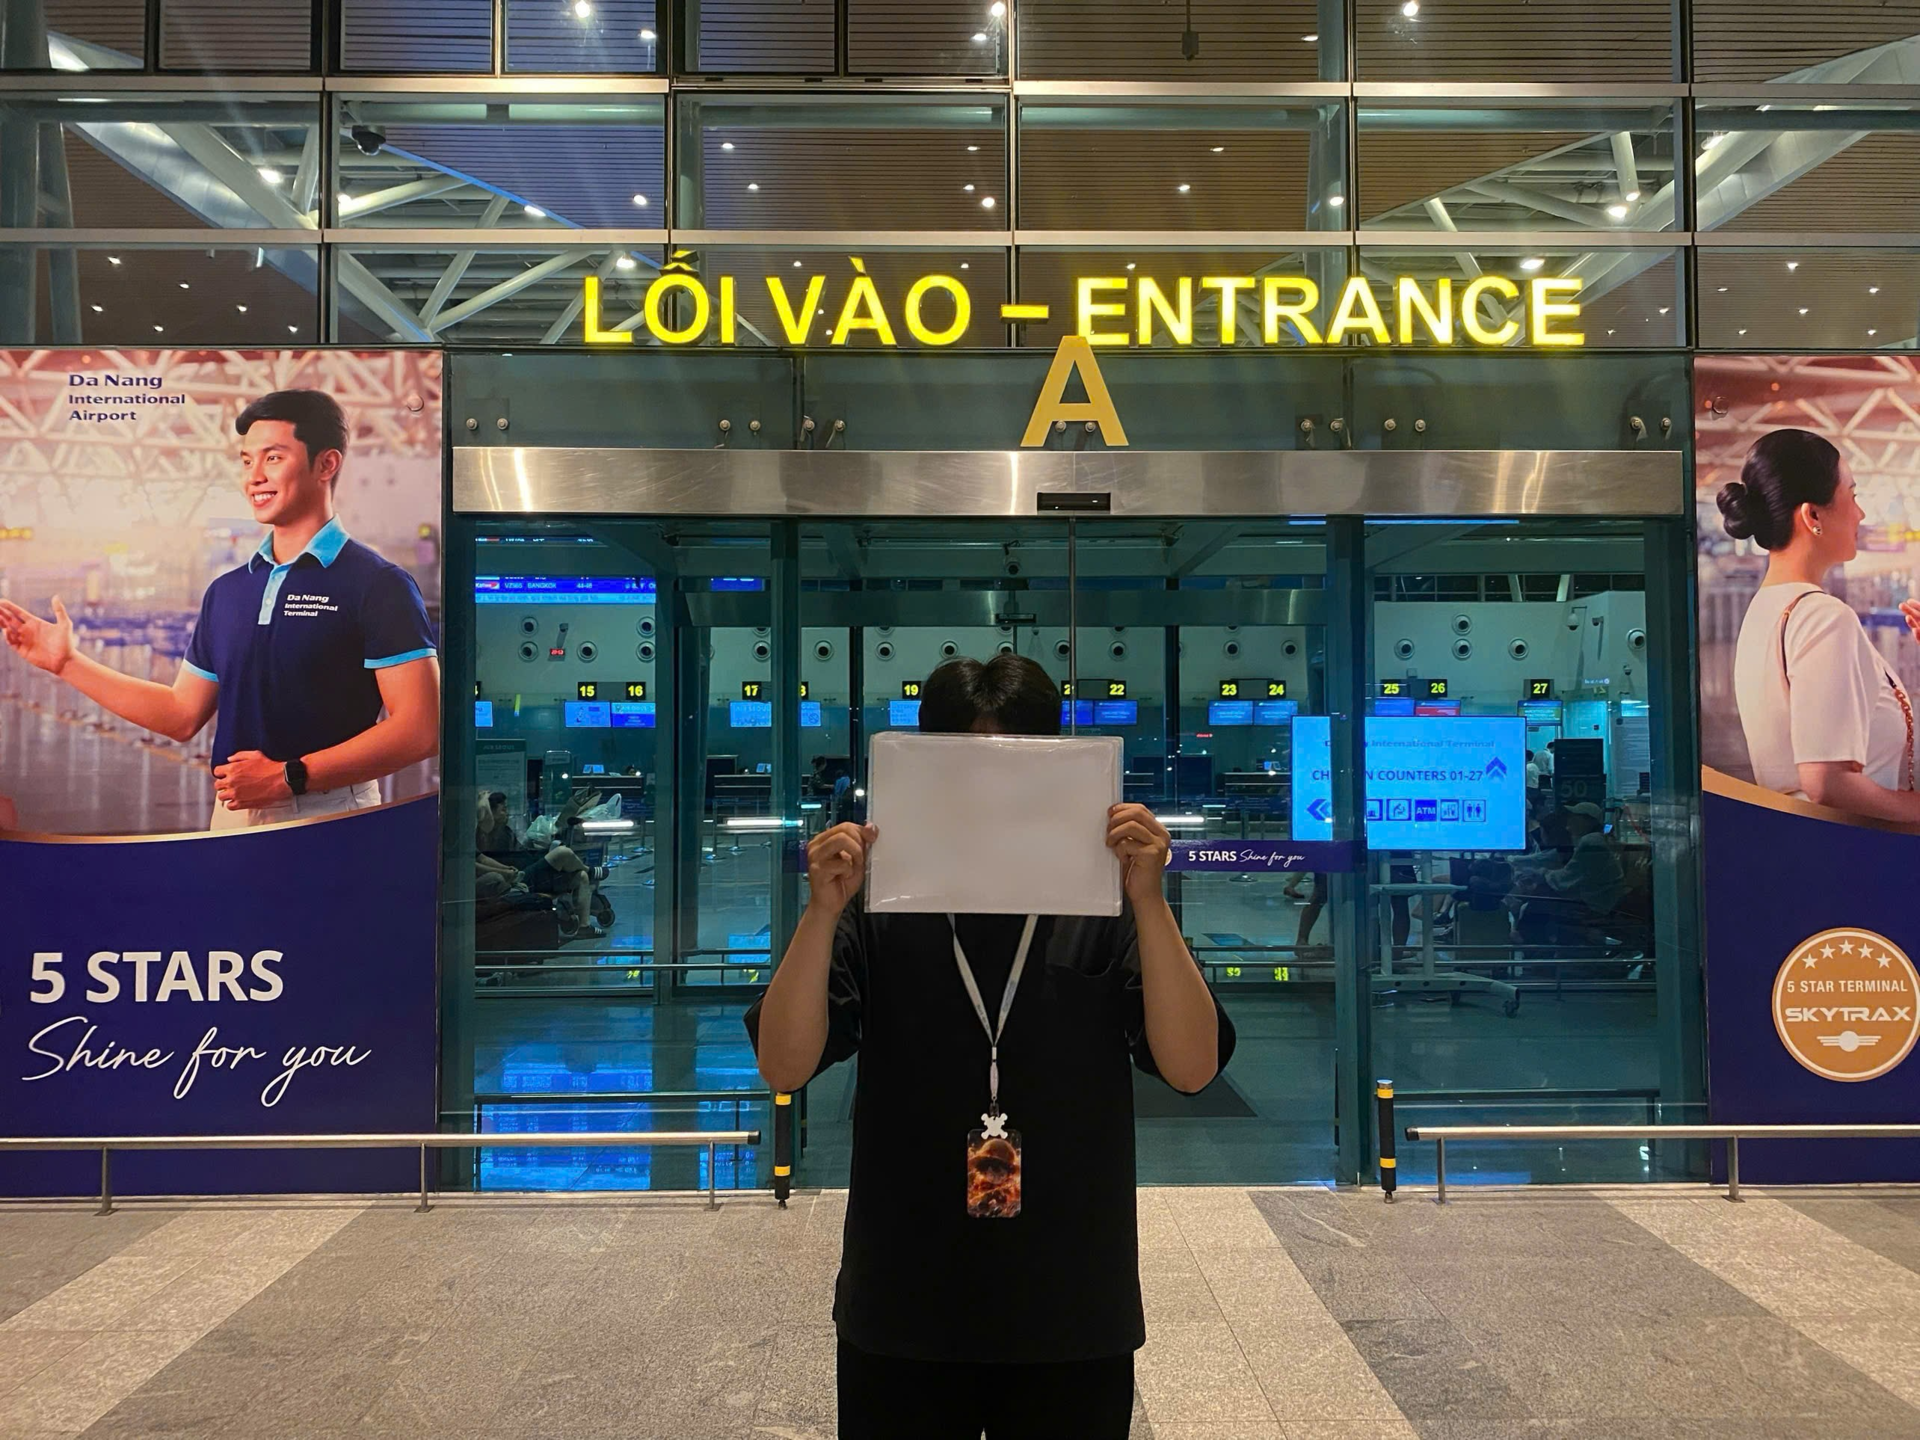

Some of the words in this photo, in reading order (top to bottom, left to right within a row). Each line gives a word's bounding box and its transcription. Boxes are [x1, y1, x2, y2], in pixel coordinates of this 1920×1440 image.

[584, 250, 736, 344] LỐI
[766, 256, 972, 346] VÀO
[1076, 276, 1586, 346] ENTRANCE
[69, 374, 98, 386] Da
[105, 374, 163, 389] Nang
[1021, 335, 1129, 447] A
[69, 394, 185, 404] International
[69, 410, 136, 422] Airport
[302, 594, 329, 603] Nang
[284, 603, 338, 611] International
[579, 685, 595, 697] 15
[628, 685, 643, 697] 16
[744, 685, 759, 697] 17
[904, 684, 919, 696] 19
[1109, 684, 1125, 695] 22
[1221, 684, 1237, 695] 23
[1268, 684, 1285, 695] 24
[1383, 682, 1400, 694] 25
[1430, 682, 1446, 694] 26
[1533, 682, 1549, 694] 27
[1371, 740, 1443, 748] International
[1447, 740, 1495, 748] Terminal
[1378, 770, 1446, 781] COUNTERS
[1450, 770, 1483, 781] 01-27
[1416, 806, 1436, 815] ATM
[1188, 851, 1196, 861] 5
[1199, 850, 1237, 862] STARS
[1239, 849, 1268, 863] Shine
[1267, 852, 1285, 866] for
[1283, 855, 1305, 868] you
[29, 952, 66, 1004] 5
[86, 950, 284, 1003] STARS
[1787, 981, 1795, 993] 5
[1800, 980, 1834, 993] STAR
[1838, 980, 1908, 993] TERMINAL
[1784, 1007, 1912, 1022] SKYTRAX
[21, 1016, 174, 1081] Shine
[173, 1027, 267, 1100] for
[260, 1040, 372, 1108] you
